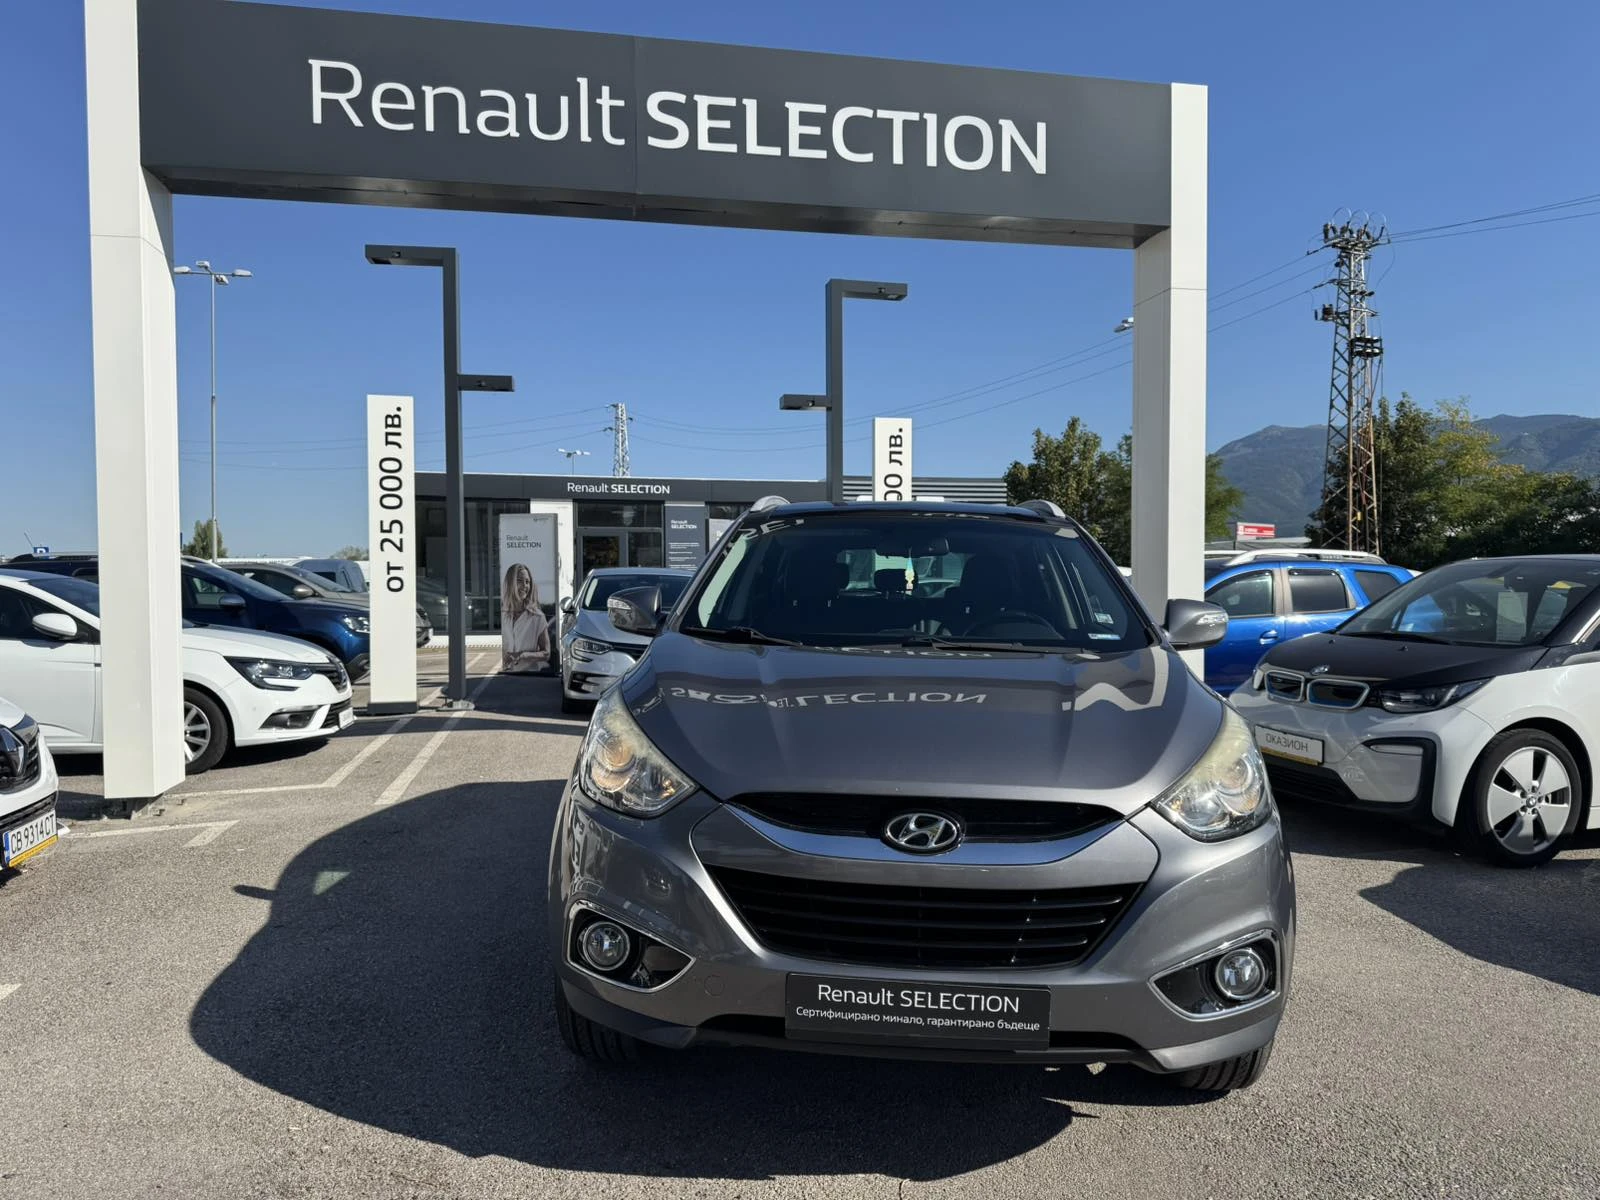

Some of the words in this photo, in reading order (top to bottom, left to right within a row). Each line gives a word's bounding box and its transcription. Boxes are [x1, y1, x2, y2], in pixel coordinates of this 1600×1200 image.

[308, 59, 626, 146] Renault
[646, 91, 1047, 174] SELECTION
[384, 406, 403, 449] лв.
[889, 427, 903, 466] лв.
[379, 456, 403, 510] 000
[567, 482, 609, 493] Renault
[611, 483, 671, 494] SELECTION
[380, 519, 404, 553] 25
[506, 541, 542, 549] SELECTION
[386, 561, 404, 593] от
[1265, 733, 1309, 752] ОКАЗИОН
[818, 984, 894, 1006] Renault
[900, 990, 1019, 1013] SELECTION
[796, 1006, 880, 1022] Сертифицирано
[883, 1014, 925, 1026] минало,
[927, 1017, 995, 1029] гарантирано
[997, 1019, 1040, 1031] бъдеще
